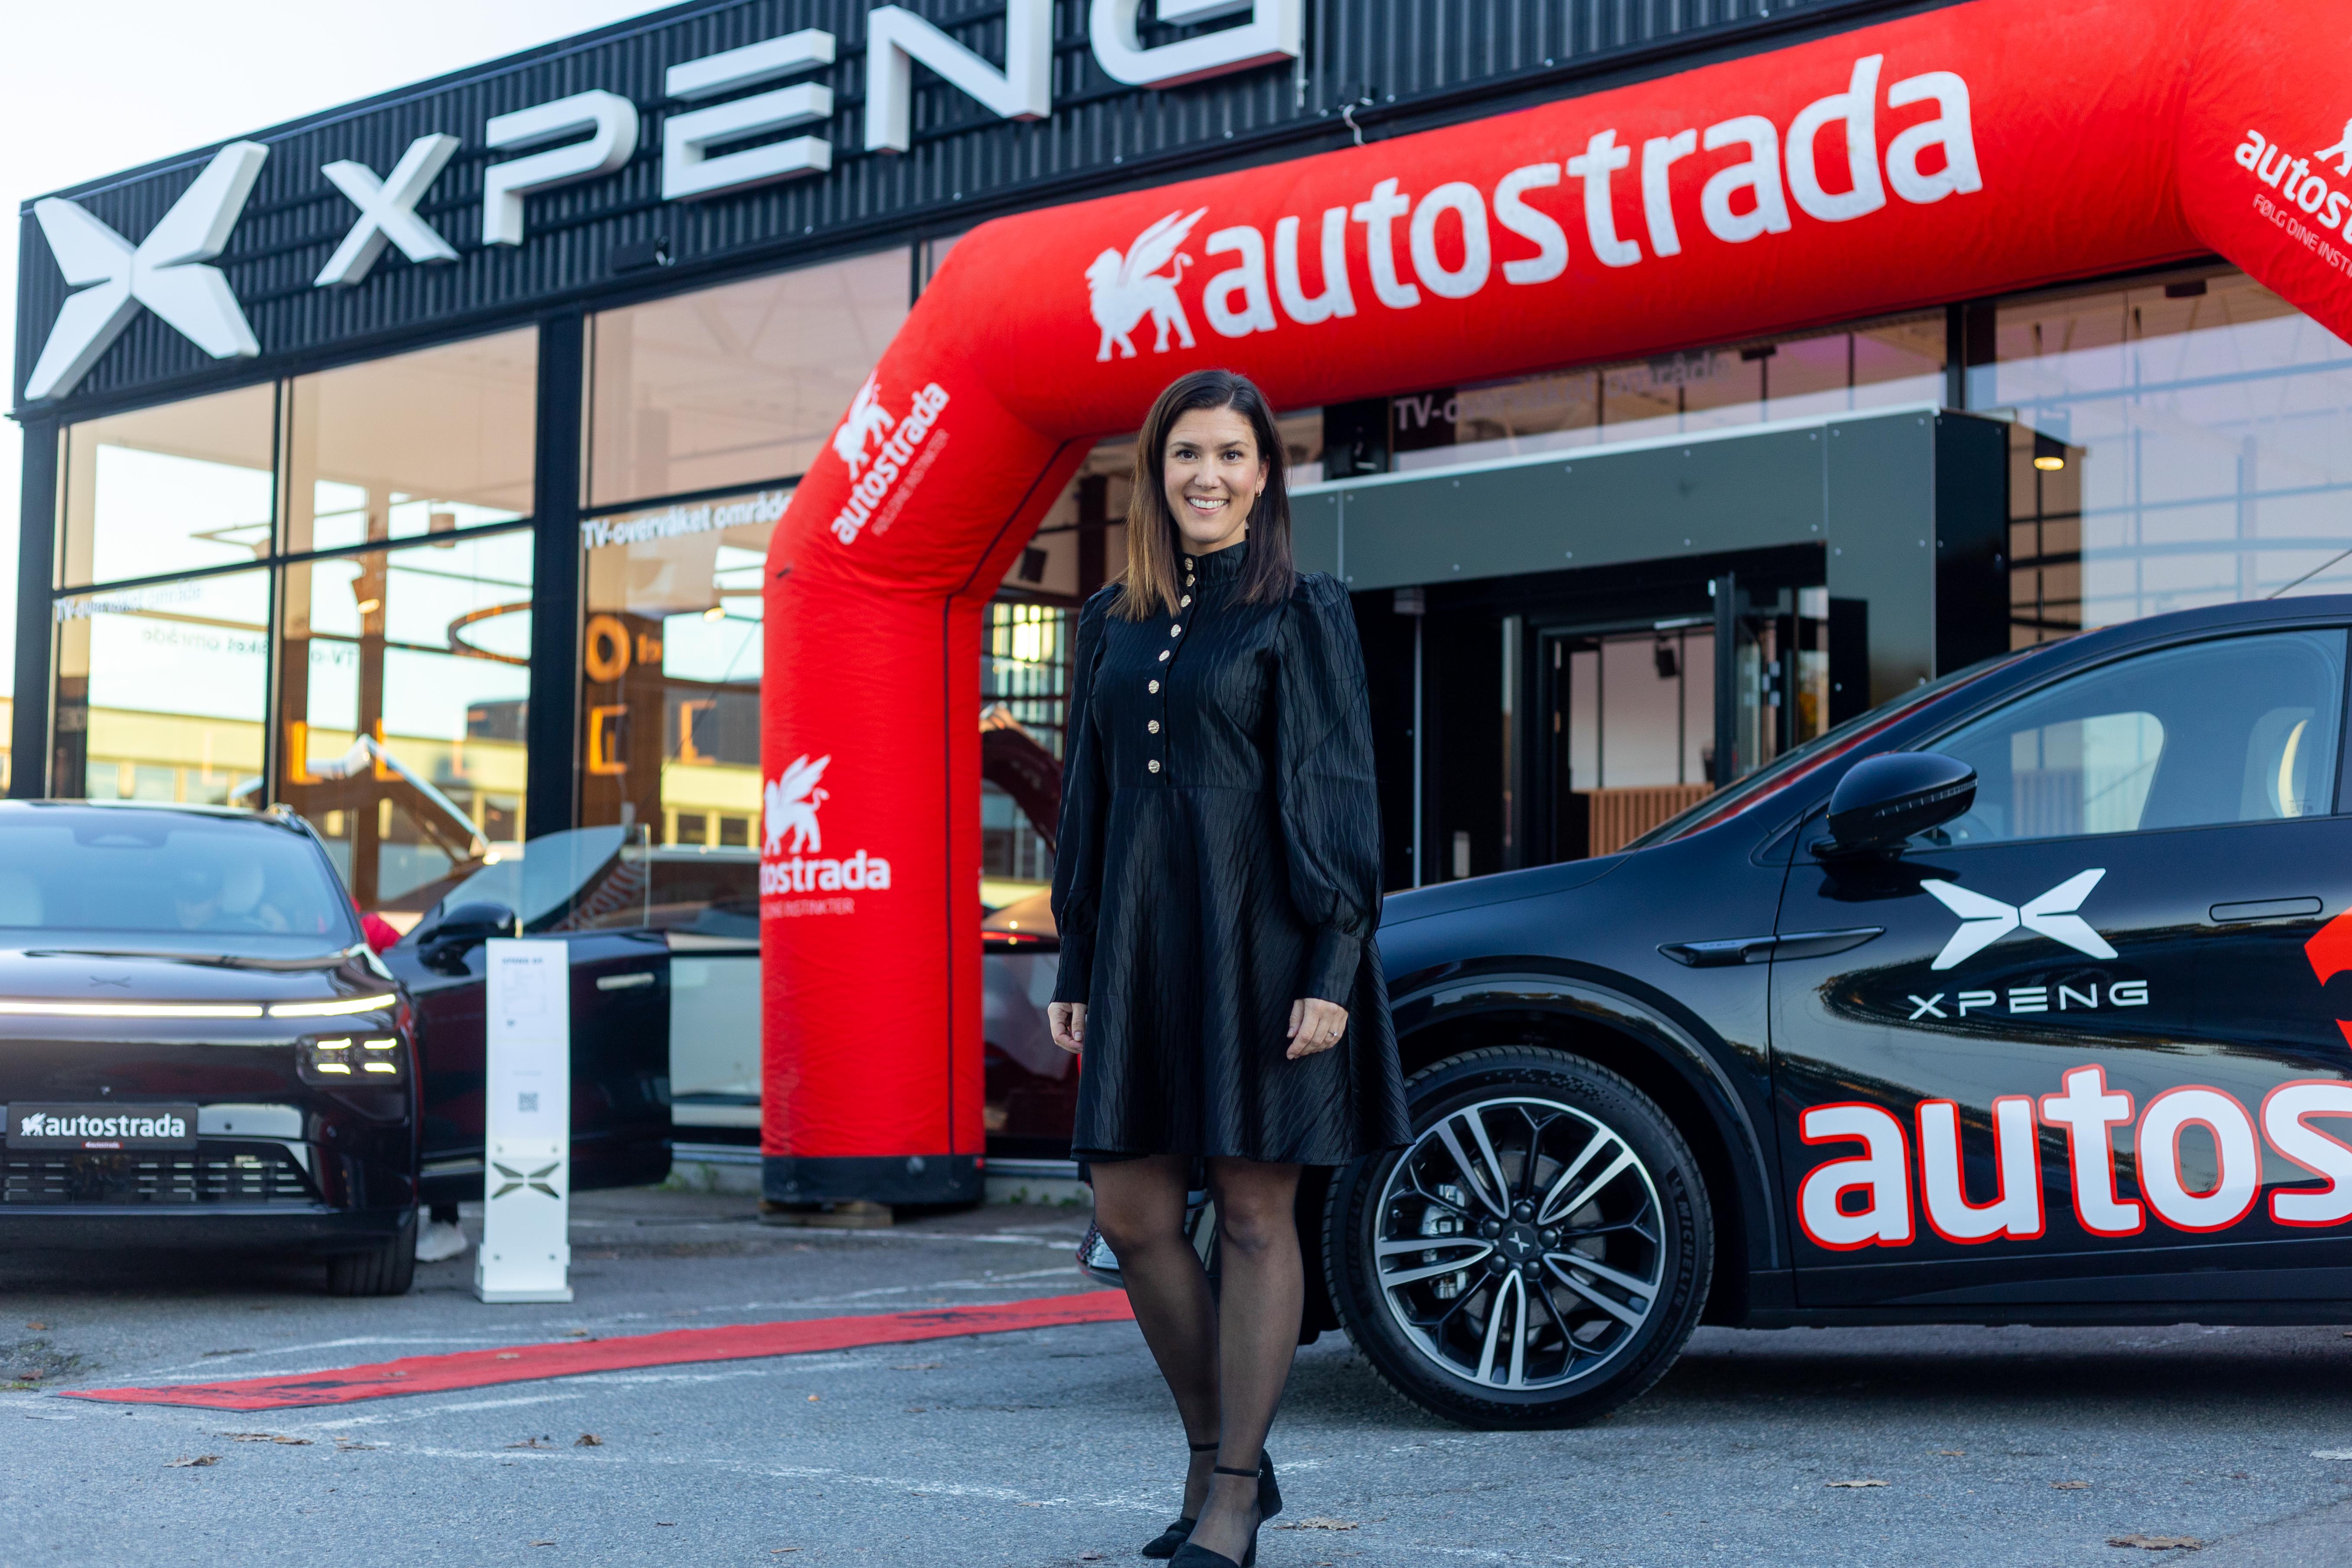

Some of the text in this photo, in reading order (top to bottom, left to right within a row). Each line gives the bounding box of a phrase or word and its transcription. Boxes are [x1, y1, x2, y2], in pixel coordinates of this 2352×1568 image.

[1202, 53, 1983, 338] autostrada
[2286, 218, 2319, 251] DINE
[831, 382, 950, 545] autostrada
[1908, 980, 2149, 1019] XPENG
[45, 1113, 186, 1138] autostrada
[1675, 1200, 1694, 1307] MICHELIN
